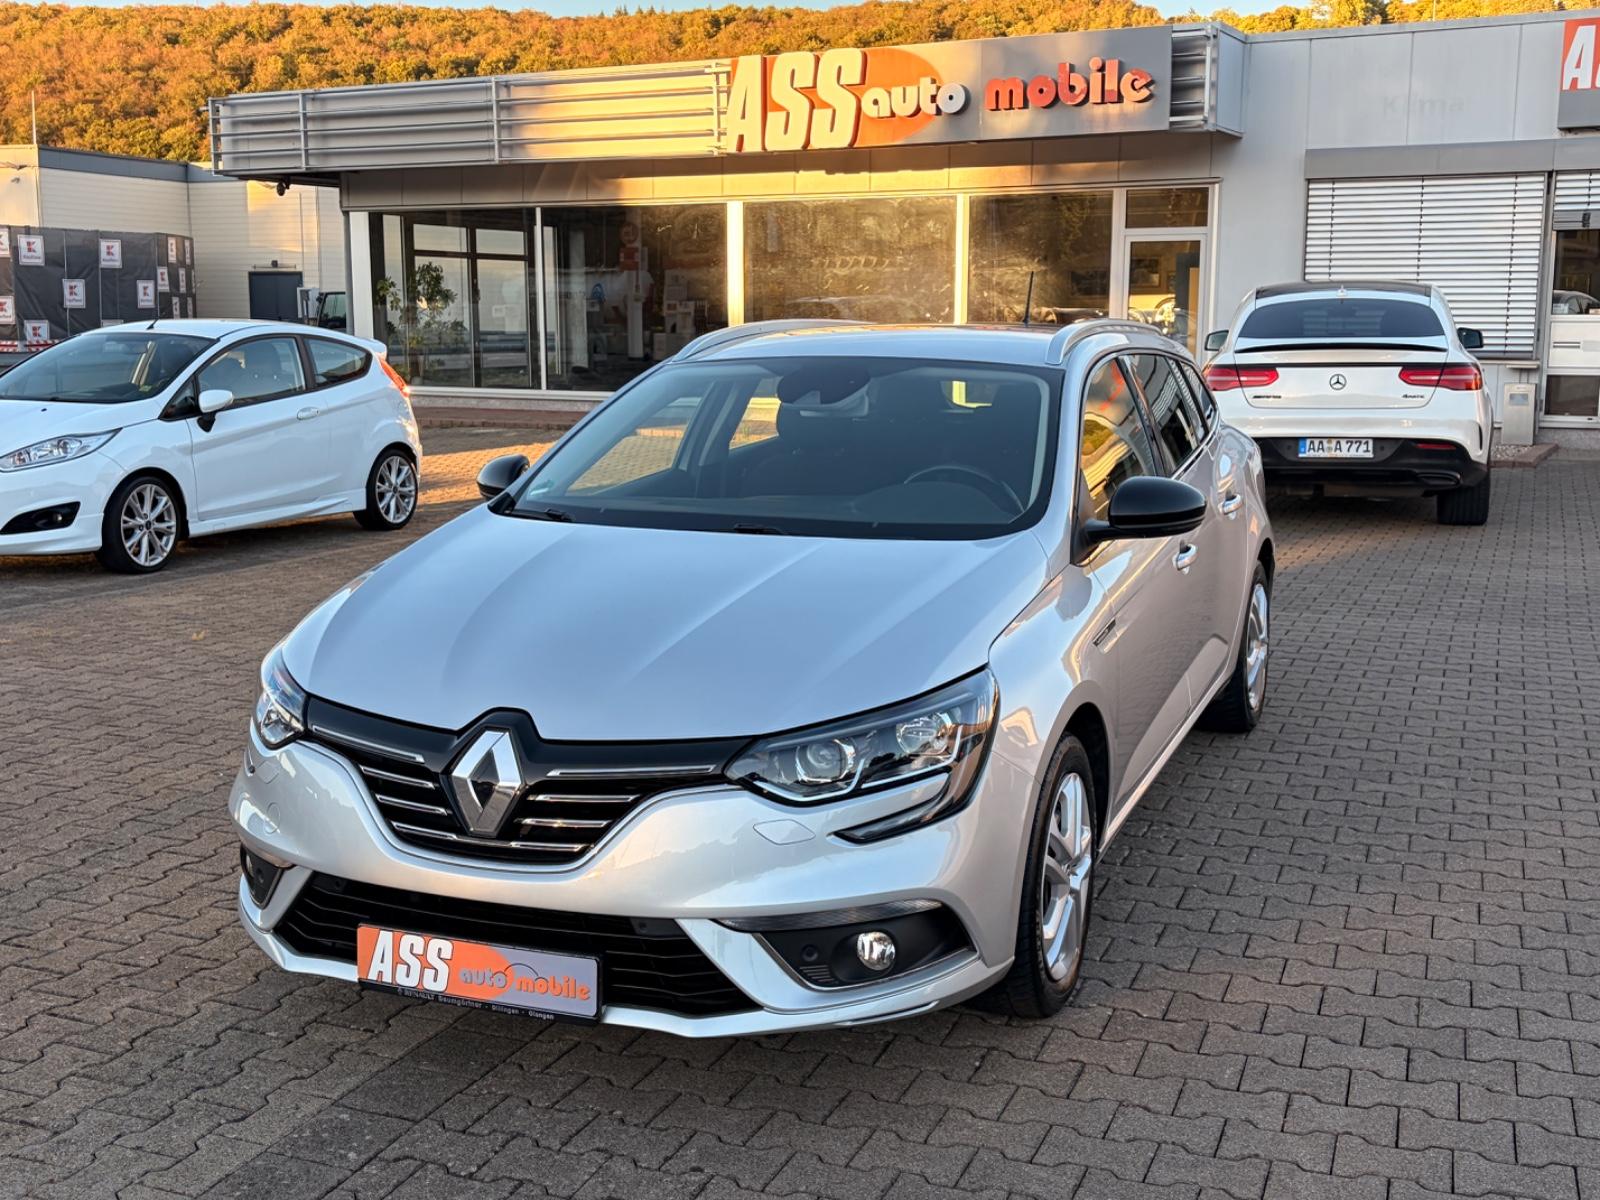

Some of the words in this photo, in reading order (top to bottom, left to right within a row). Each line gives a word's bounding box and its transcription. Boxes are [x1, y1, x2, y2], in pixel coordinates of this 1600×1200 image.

[1562, 25, 1600, 91] A
[727, 48, 866, 152] ASS
[861, 76, 967, 118] auto
[984, 56, 1154, 111] mobile
[1308, 440, 1325, 453] AA
[1346, 440, 1371, 453] 771
[368, 930, 453, 992] ASS
[459, 967, 508, 989] auto
[516, 974, 591, 1001] mobile
